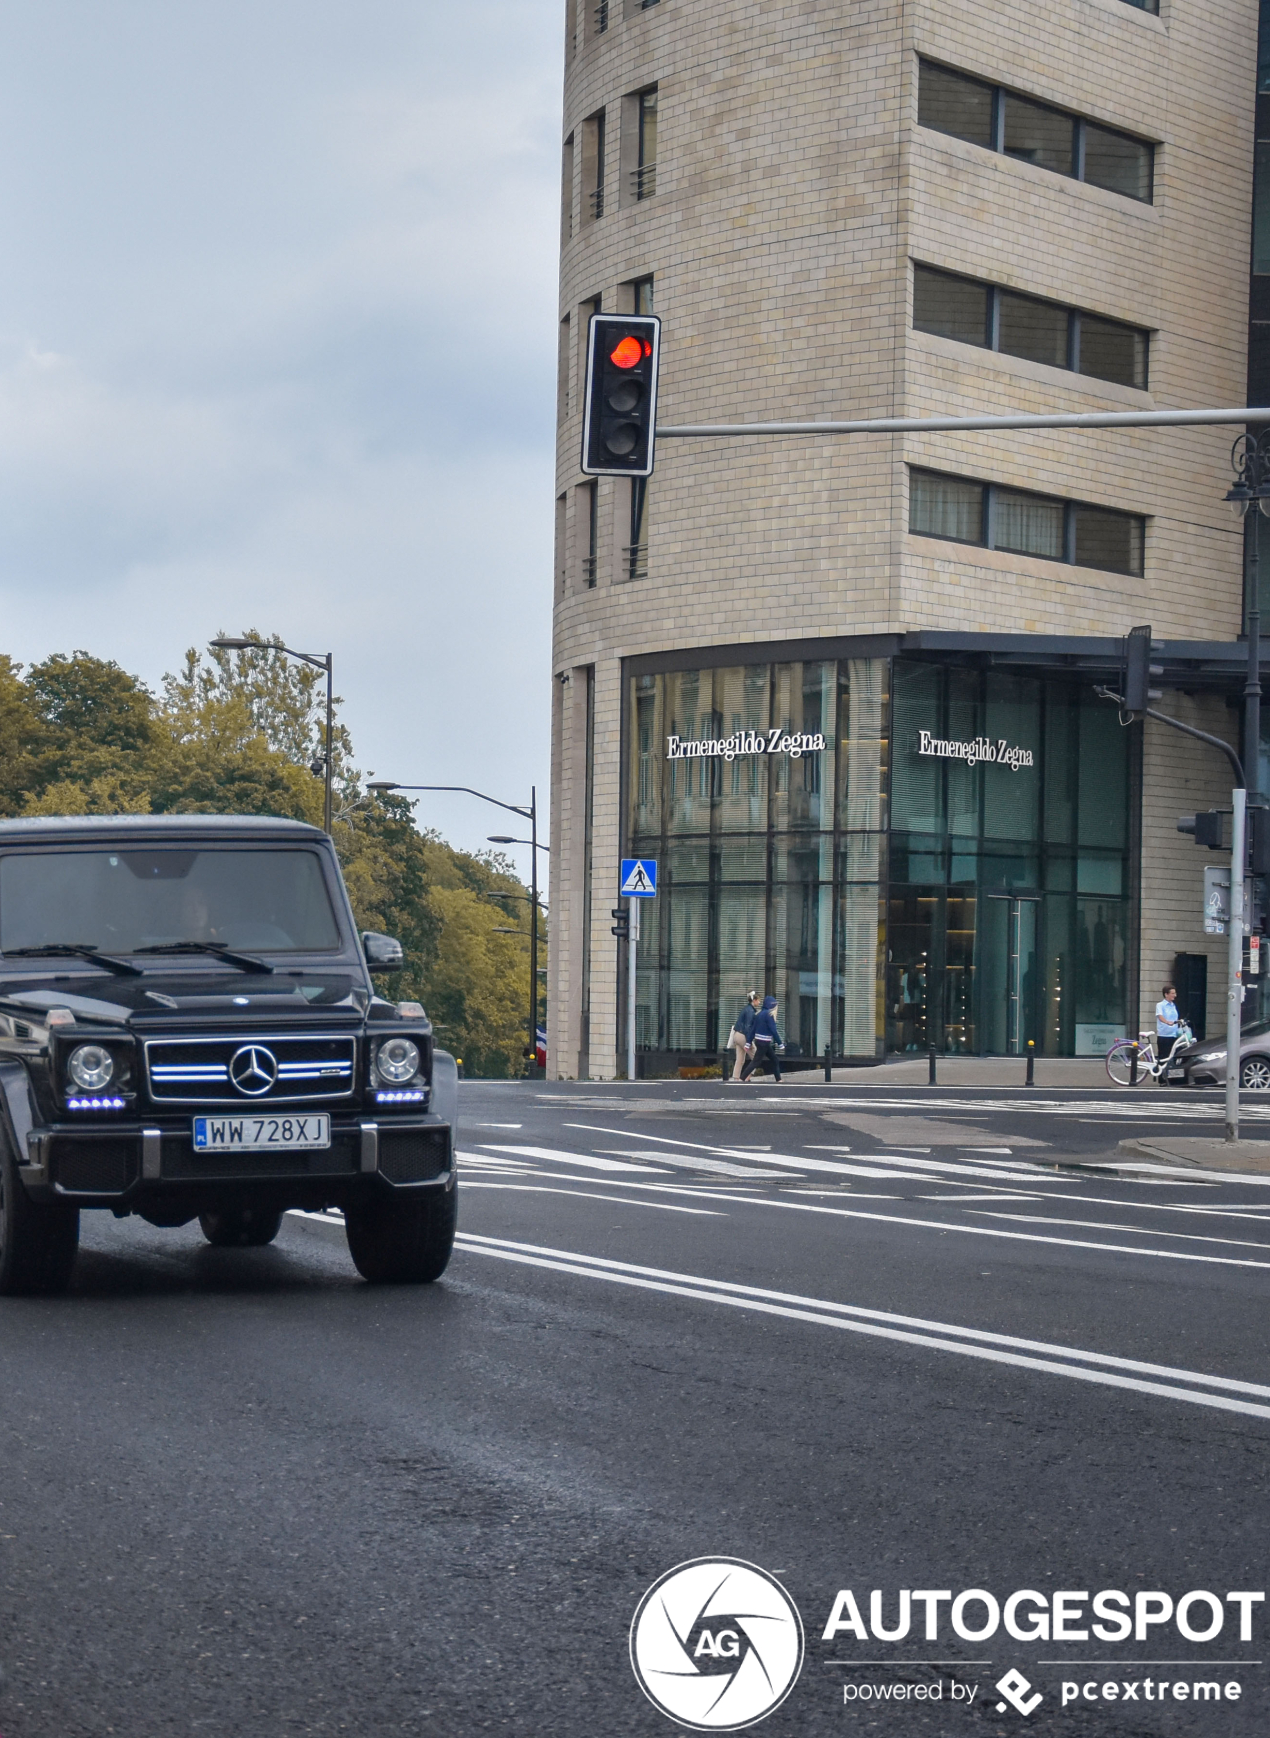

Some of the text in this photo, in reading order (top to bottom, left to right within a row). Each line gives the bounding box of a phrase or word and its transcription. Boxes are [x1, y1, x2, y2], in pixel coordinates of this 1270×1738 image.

[666, 728, 826, 762] Ermenegildo Zegna
[918, 730, 1033, 771] Ermenegildo Zegna
[210, 1118, 323, 1144] WW 728XJ
